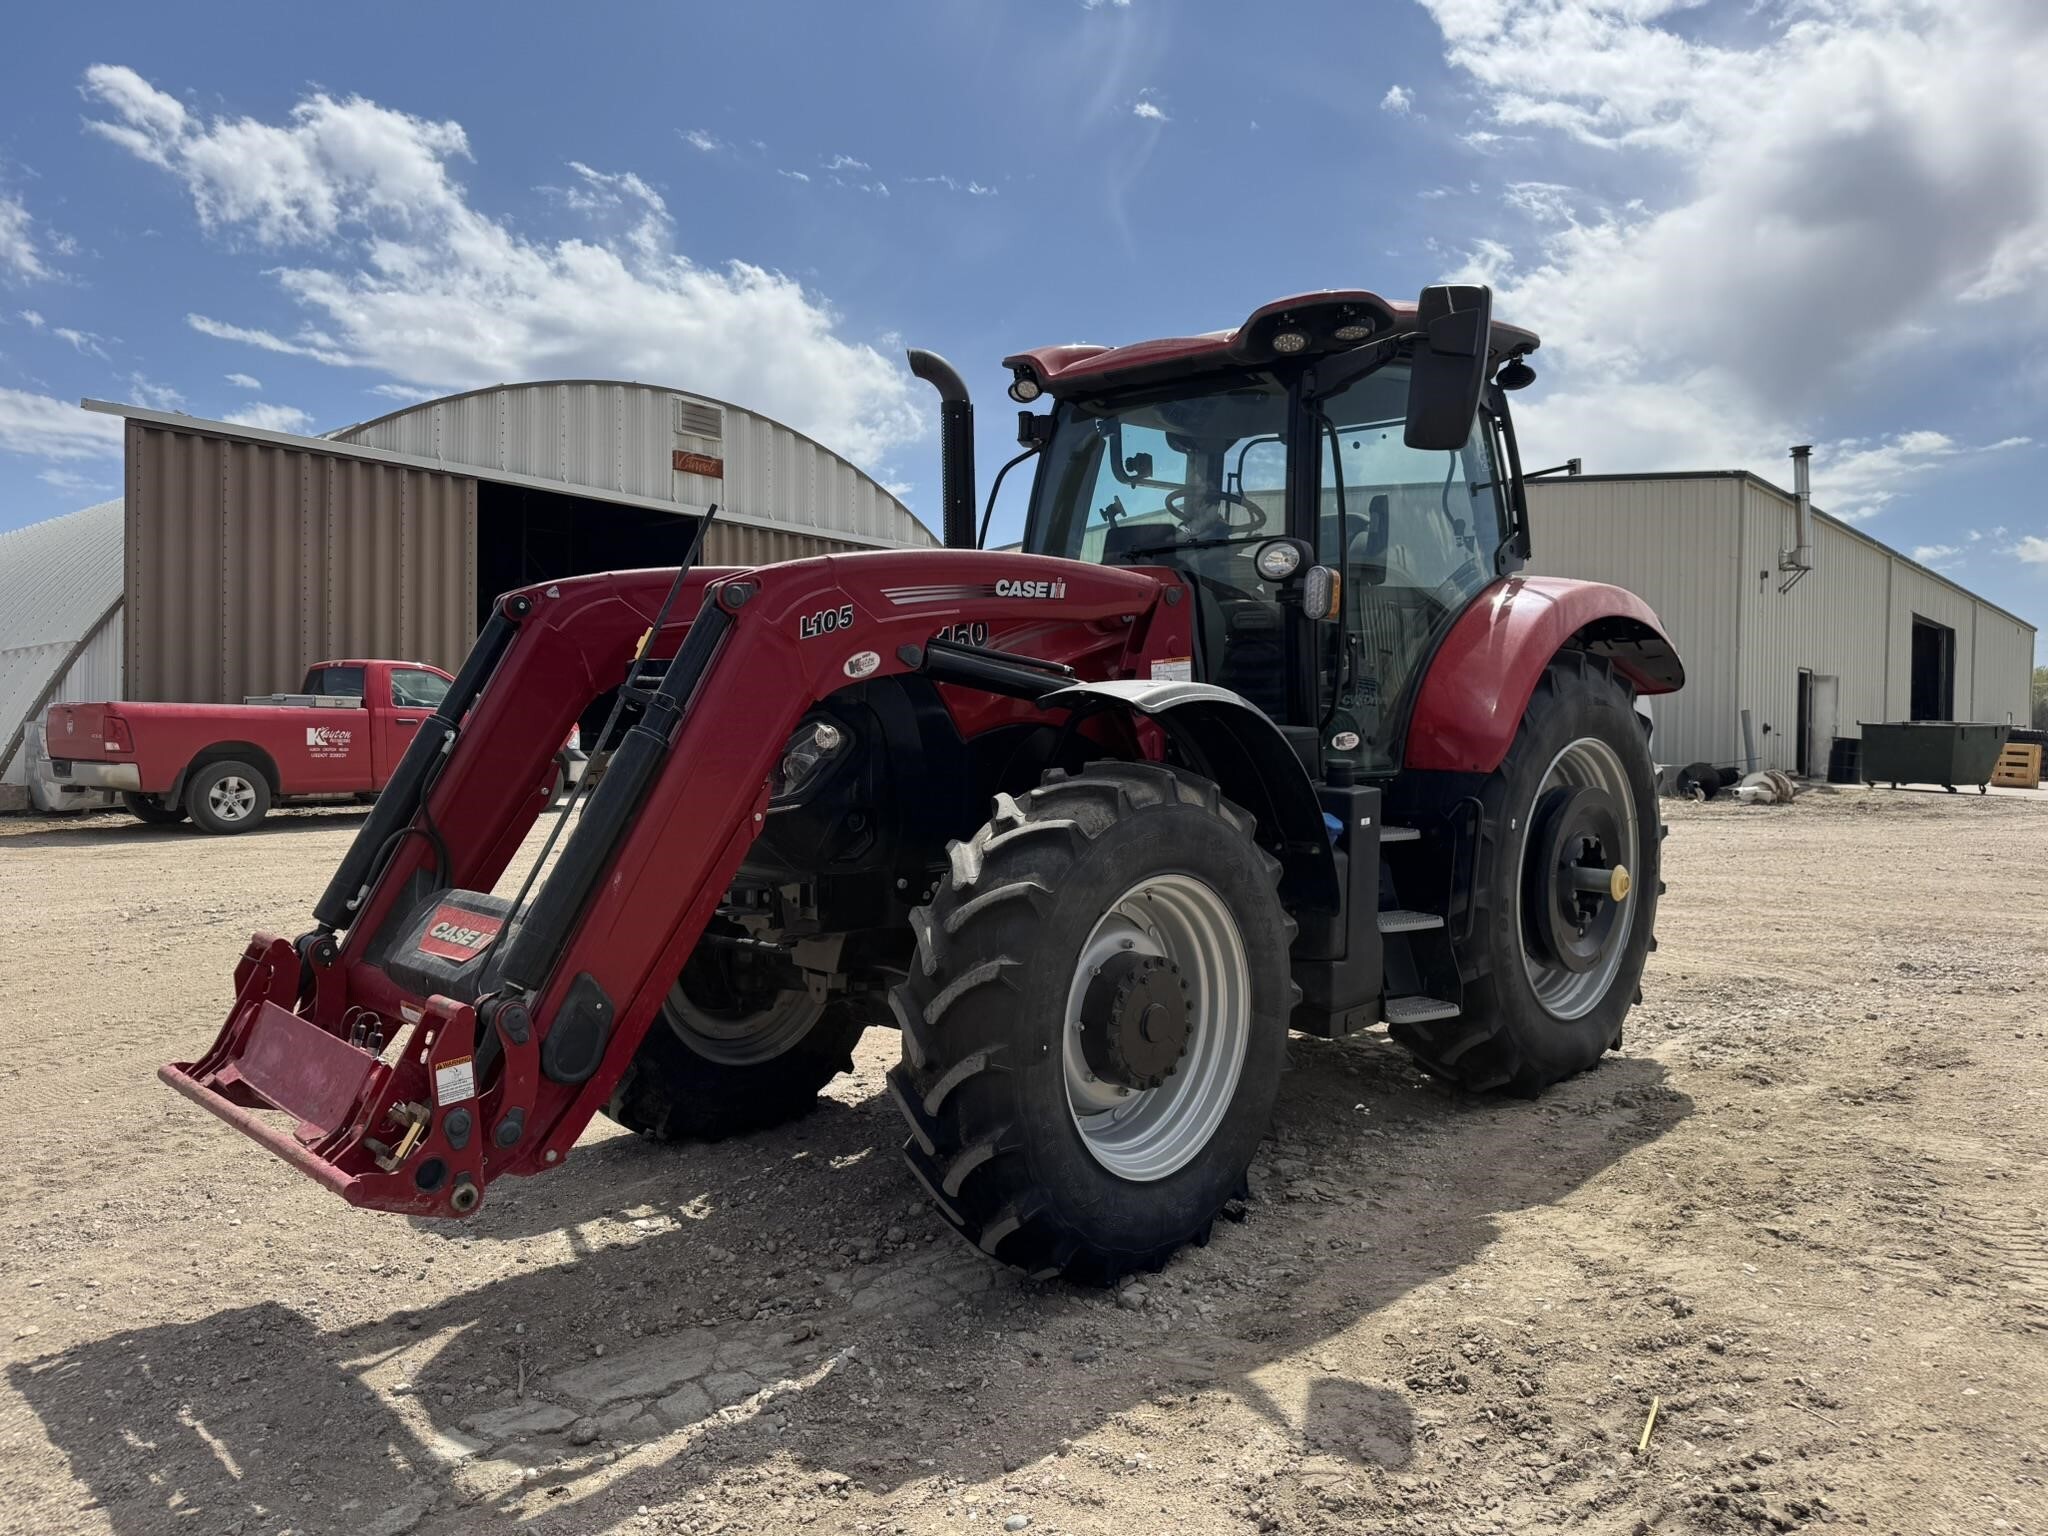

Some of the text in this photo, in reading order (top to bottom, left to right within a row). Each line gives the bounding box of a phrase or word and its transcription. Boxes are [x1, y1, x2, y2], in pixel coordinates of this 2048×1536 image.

[996, 579, 1048, 598] CASE
[800, 604, 853, 640] L105
[430, 921, 480, 946] CASE
